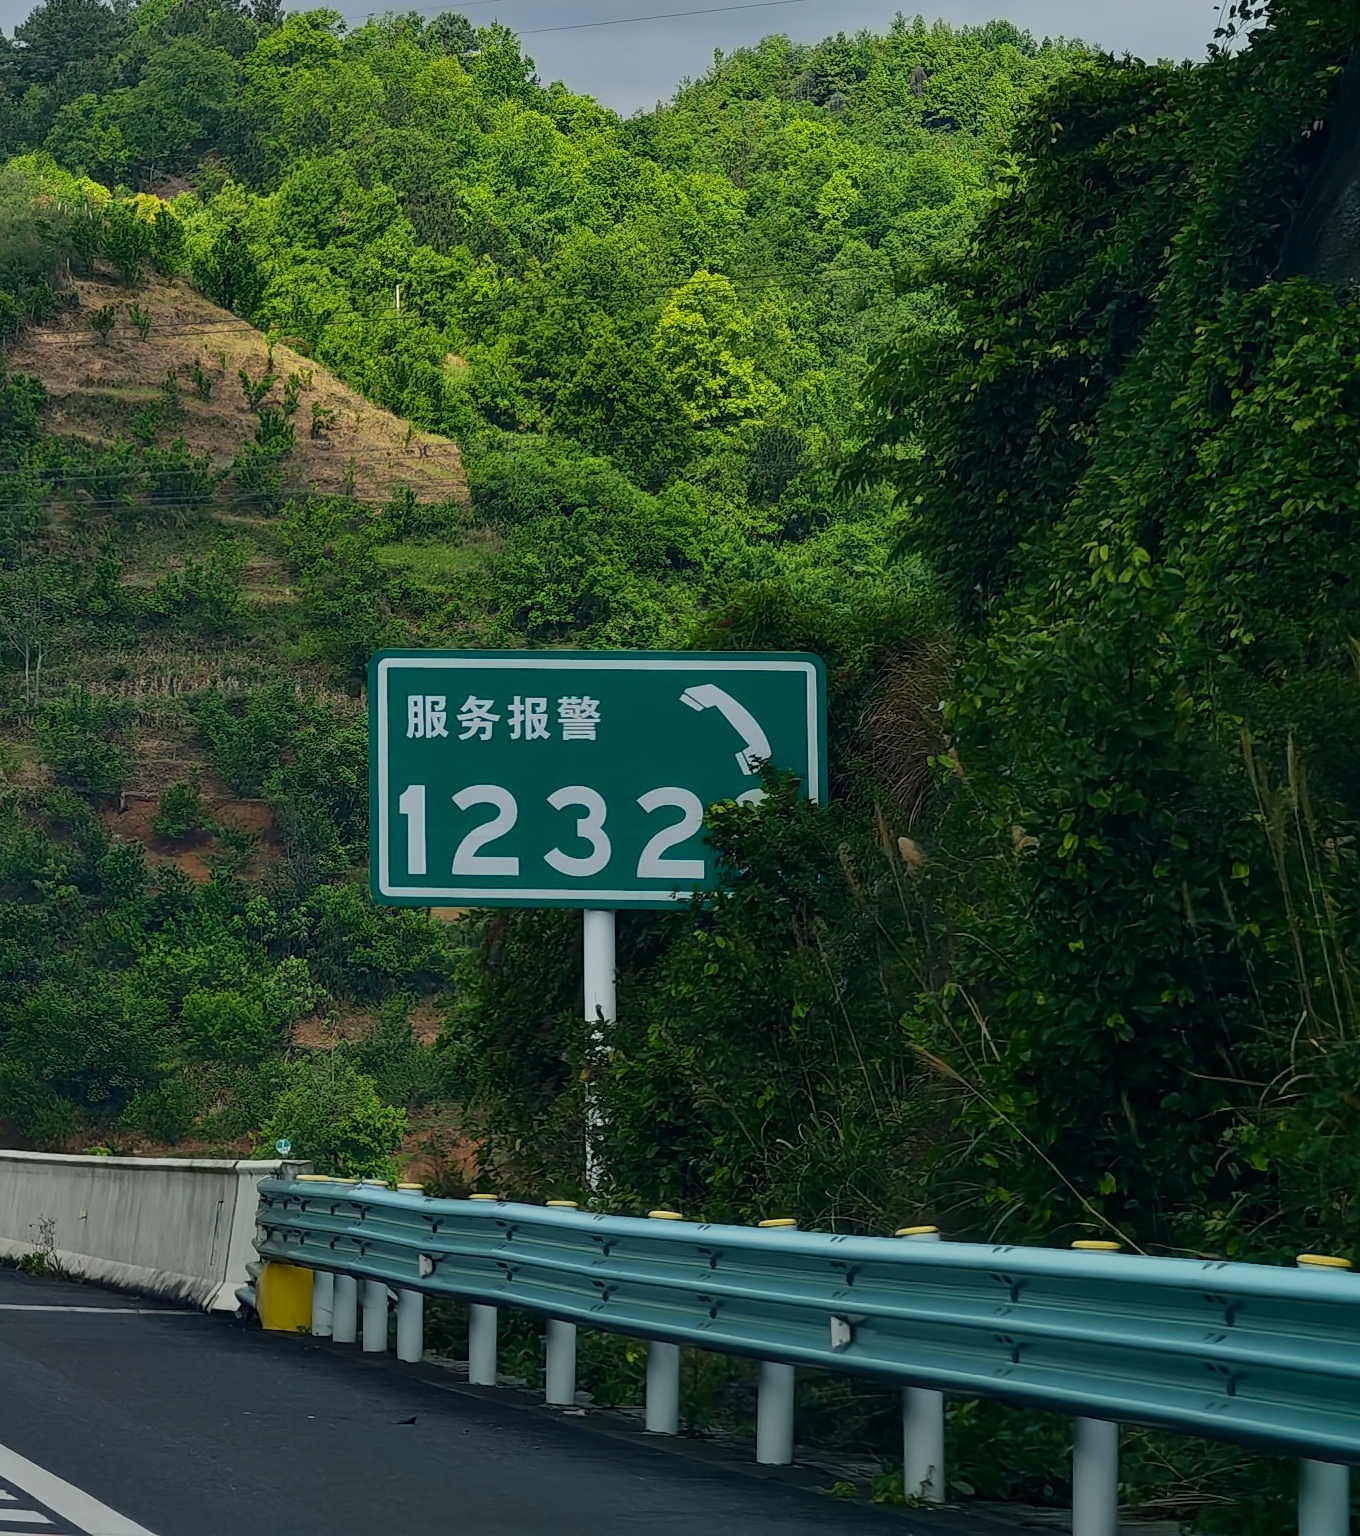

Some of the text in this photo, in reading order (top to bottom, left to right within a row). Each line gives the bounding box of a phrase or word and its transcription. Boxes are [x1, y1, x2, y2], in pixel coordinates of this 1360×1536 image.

[406, 695, 601, 741] 服务报警
[399, 784, 770, 880] 1232
